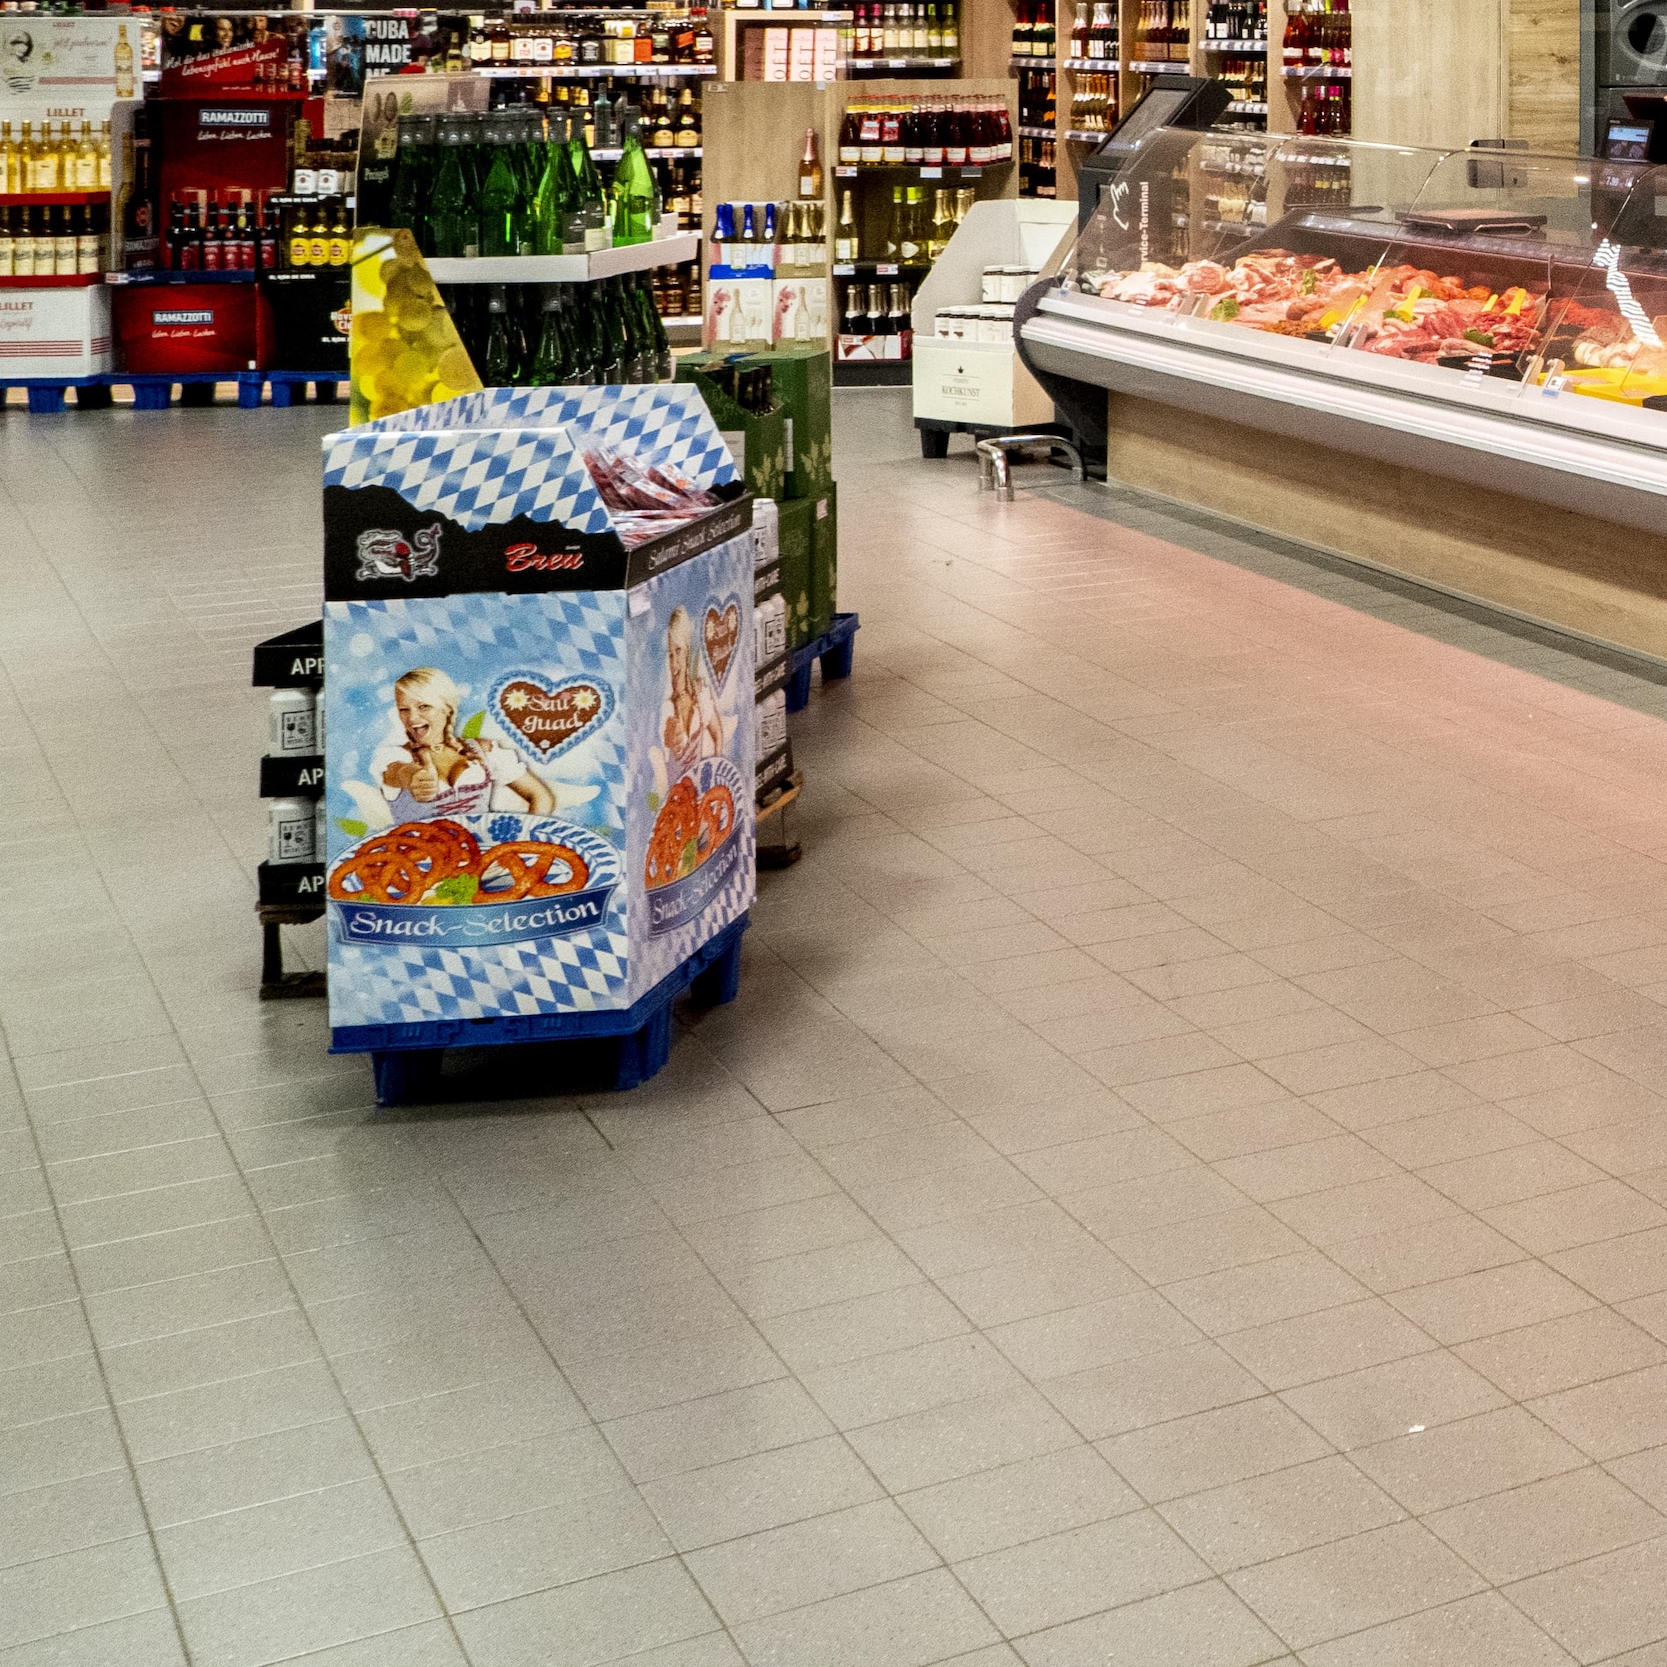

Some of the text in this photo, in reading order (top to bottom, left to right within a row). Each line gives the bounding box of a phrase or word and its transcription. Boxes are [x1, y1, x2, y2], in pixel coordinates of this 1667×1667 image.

[366, 20, 409, 39] CUBA
[366, 44, 412, 63] MADE
[47, 108, 86, 118] LILLET
[202, 112, 268, 124] RAMAZZOTTI
[154, 313, 212, 324] RAMAZZOTTI
[505, 542, 584, 572] Breu
[528, 695, 572, 713] Sau
[523, 712, 582, 732] guad
[652, 845, 738, 925] Snack-Selection
[350, 898, 599, 939] Snack-Selection
